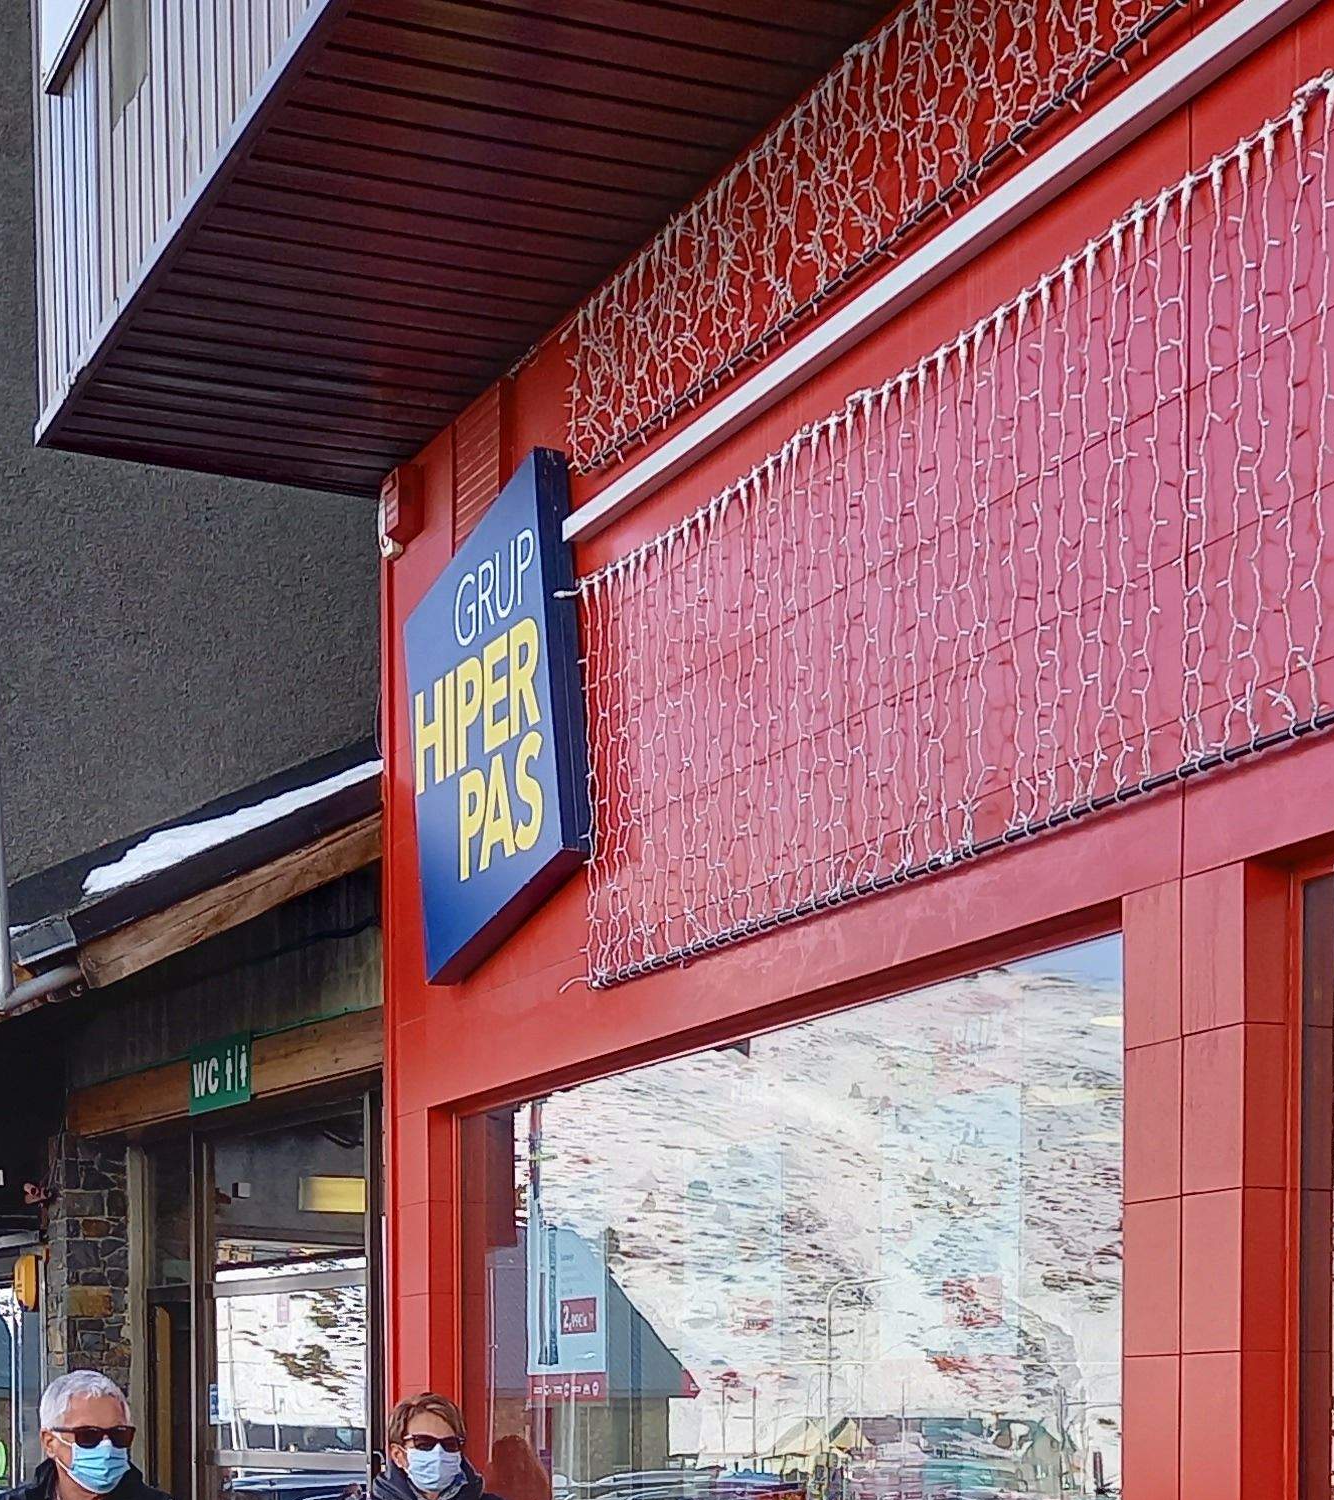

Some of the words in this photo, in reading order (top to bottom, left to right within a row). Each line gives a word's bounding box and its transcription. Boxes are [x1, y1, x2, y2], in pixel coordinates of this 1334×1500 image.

[454, 528, 535, 646] GRUP
[415, 617, 541, 797] HIPER
[458, 730, 544, 882] PAS
[193, 1057, 219, 1098] WC
